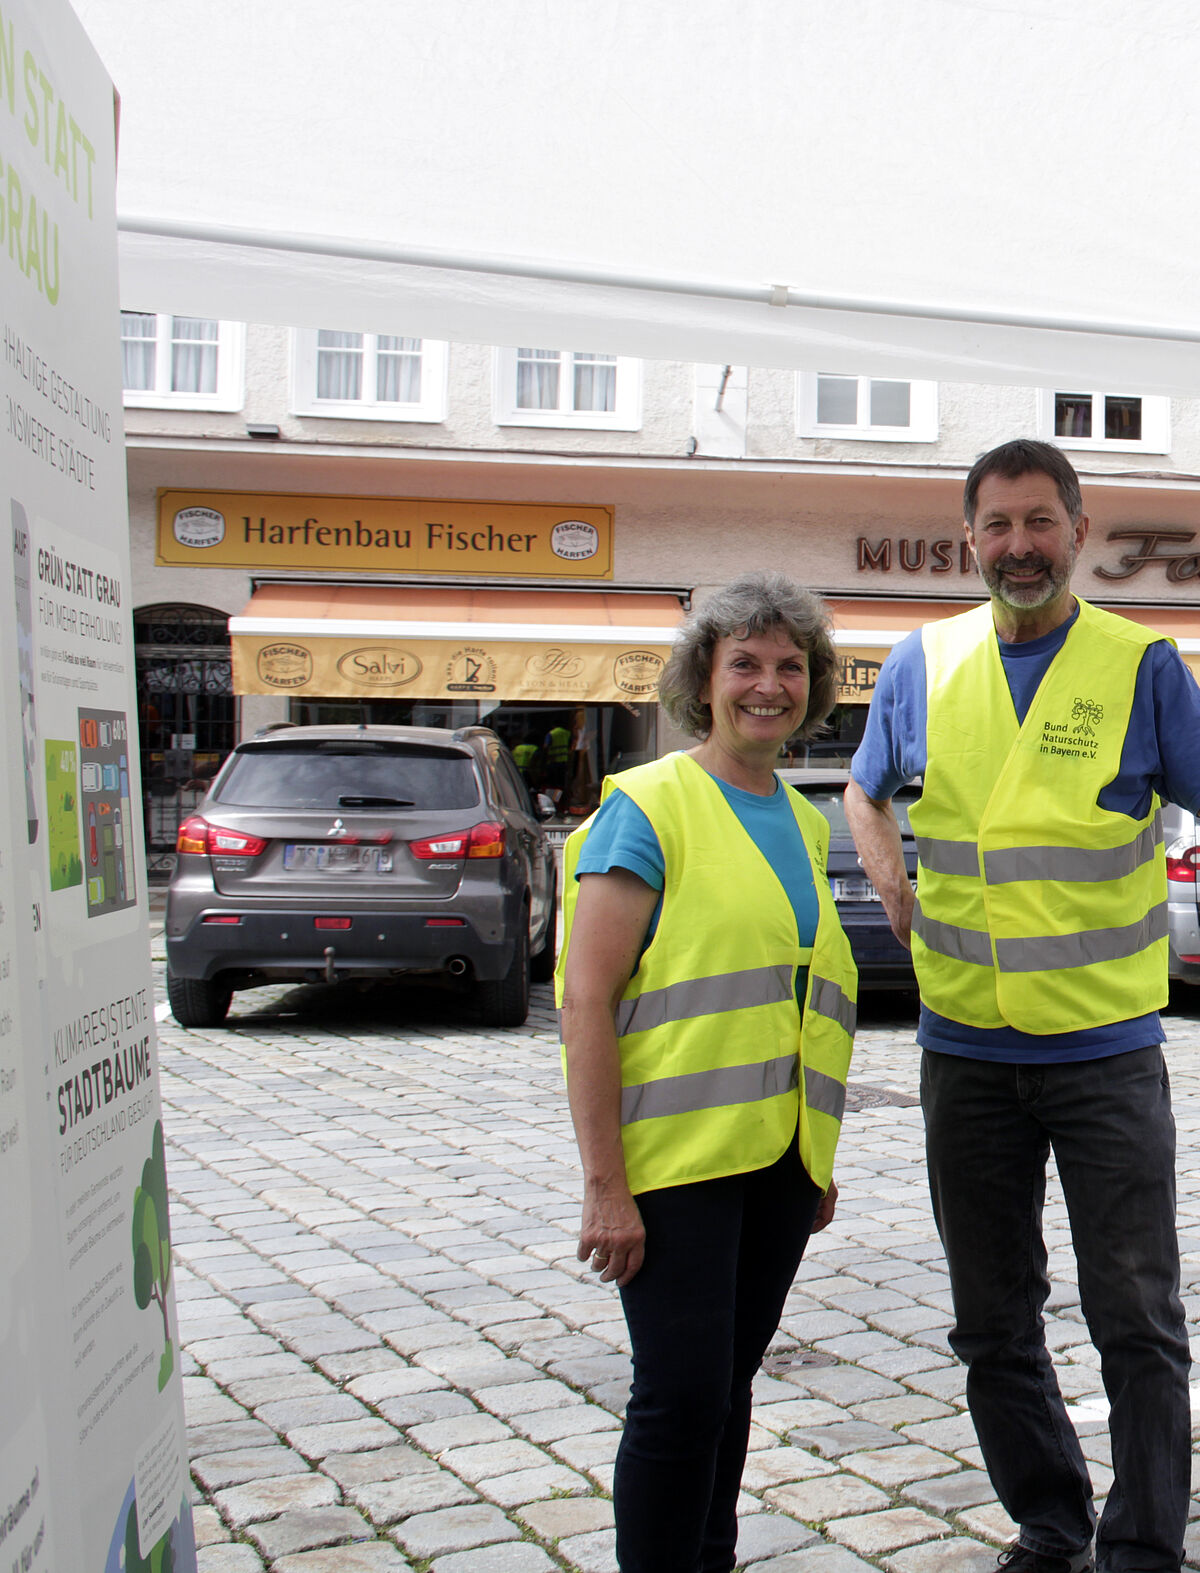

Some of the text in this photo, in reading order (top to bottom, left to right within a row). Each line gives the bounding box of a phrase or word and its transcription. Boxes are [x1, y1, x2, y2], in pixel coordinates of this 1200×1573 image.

[23, 49, 96, 222] STATT
[51, 370, 111, 443] GESTALTUNG
[59, 438, 95, 491] STÄDTE
[178, 510, 221, 521] FISCHER
[242, 516, 538, 552] Harfenbau Fischer
[555, 524, 594, 534] FISCHER
[179, 534, 220, 546] HARFEN
[556, 548, 593, 558] HARFEN
[857, 537, 979, 573] MUSI
[38, 545, 121, 608] GRÜN STATT GRAU
[39, 593, 54, 627] FÜR
[56, 603, 78, 635] MEHR
[262, 647, 308, 658] FISCHER
[619, 655, 661, 666] FISCHER
[353, 654, 405, 675] Salvi
[264, 674, 306, 685] HARFEN
[1044, 722, 1068, 732] Bund
[1042, 733, 1098, 749] Naturschutz
[1040, 744, 1096, 760] in Bayern e.V.
[54, 988, 148, 1068] KLIMARESISTENTE
[58, 1036, 151, 1136] STADTBÄUME
[60, 1144, 72, 1176] FÜR
[74, 1109, 126, 1165] DEUTSCHLAND
